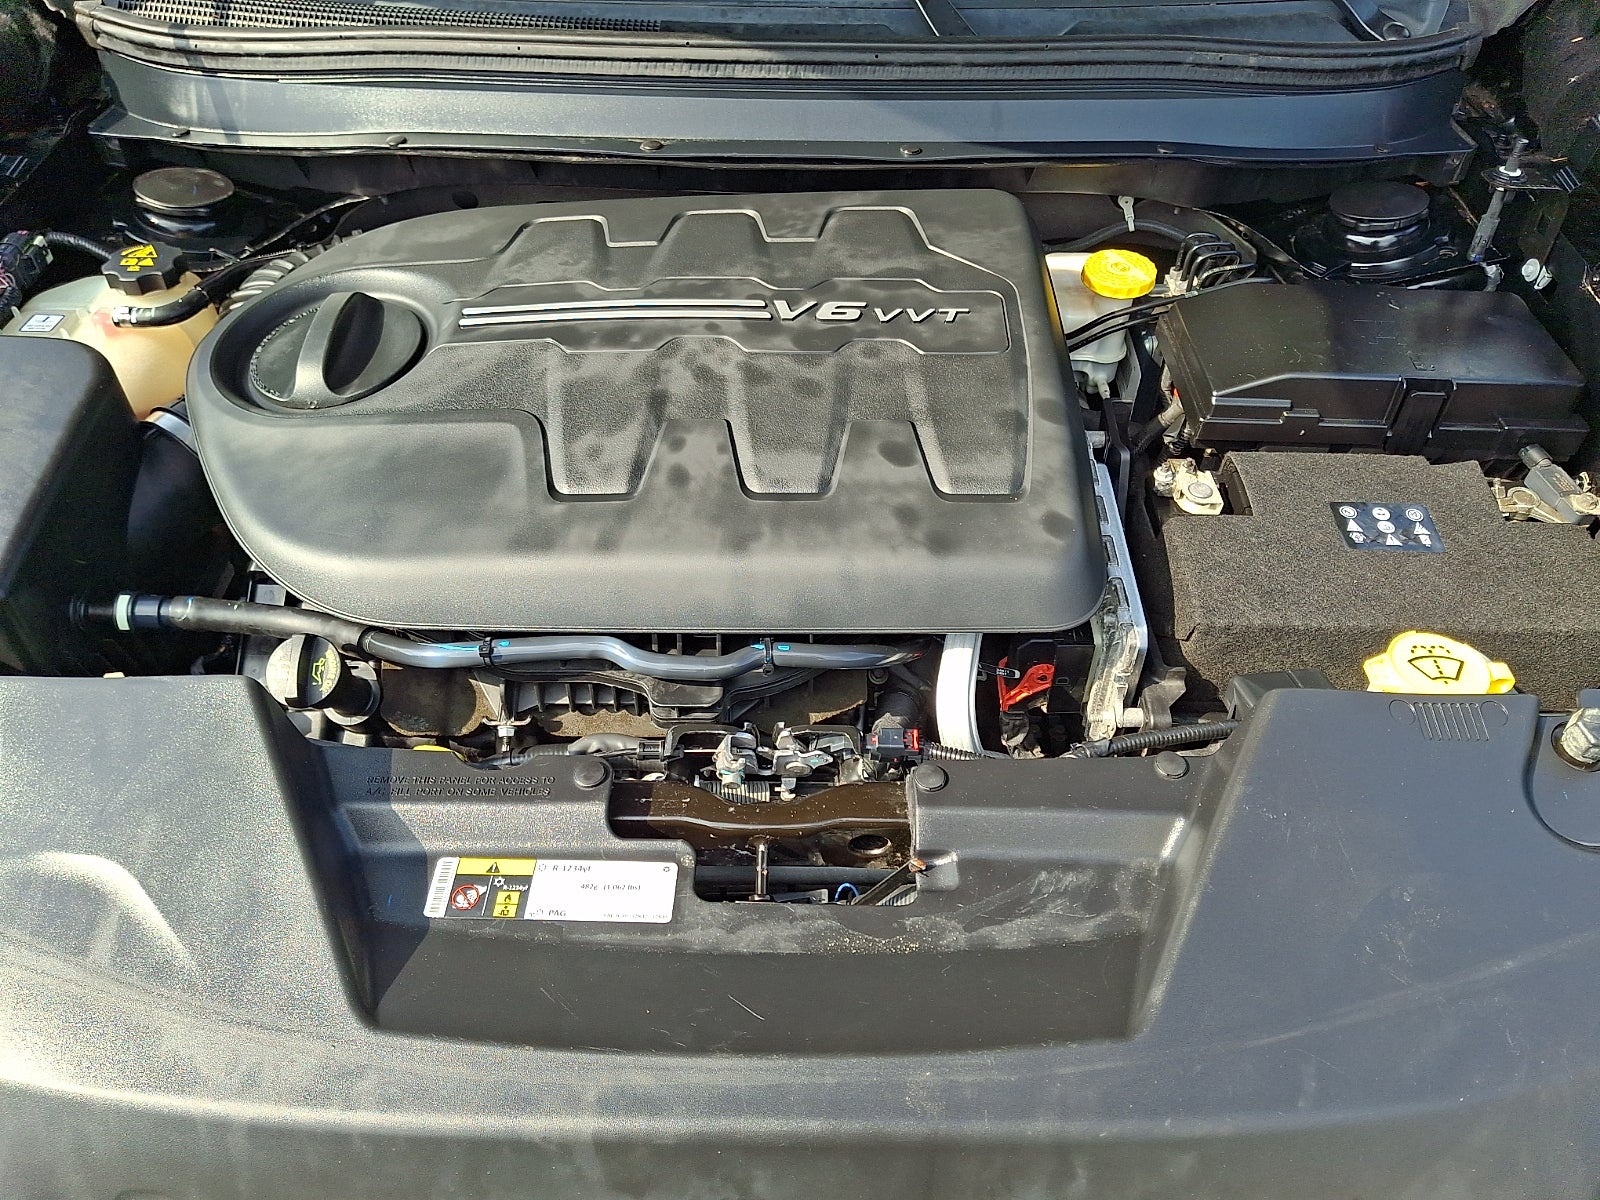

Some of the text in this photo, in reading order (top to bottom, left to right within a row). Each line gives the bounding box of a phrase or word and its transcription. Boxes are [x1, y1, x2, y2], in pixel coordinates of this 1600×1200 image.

[773, 299, 971, 324] V6 VVT
[366, 776, 556, 785] REMOVE THIS PANEL FOR ACCESS TO
[390, 787, 411, 796] FILL
[415, 787, 444, 796] PORT
[446, 787, 464, 796] ON
[465, 787, 497, 796] SOME
[500, 787, 551, 797] VEHICLES
[548, 909, 567, 917] PAG
